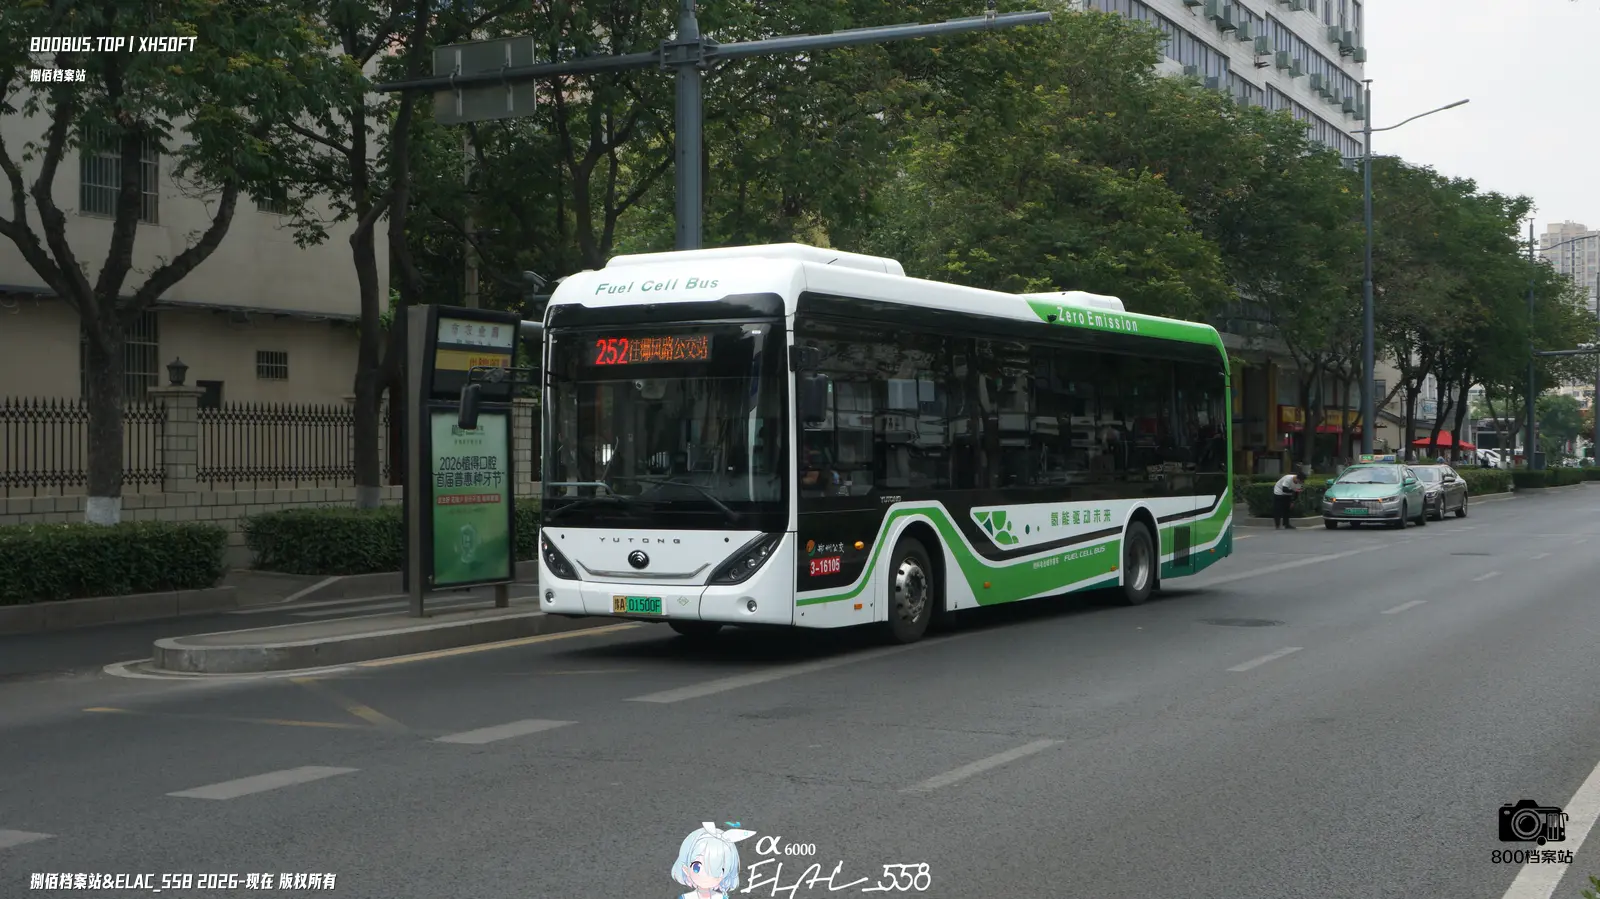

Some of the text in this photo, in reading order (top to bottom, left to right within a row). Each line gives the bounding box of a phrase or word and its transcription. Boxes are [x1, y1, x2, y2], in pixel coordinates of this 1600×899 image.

[595, 277, 720, 295] Fuel Cell Bus
[1056, 305, 1138, 332] Zero Emission
[595, 337, 629, 365] 252
[1064, 545, 1106, 562] FUEL CELL BUS
[810, 558, 840, 575] 3-16105
